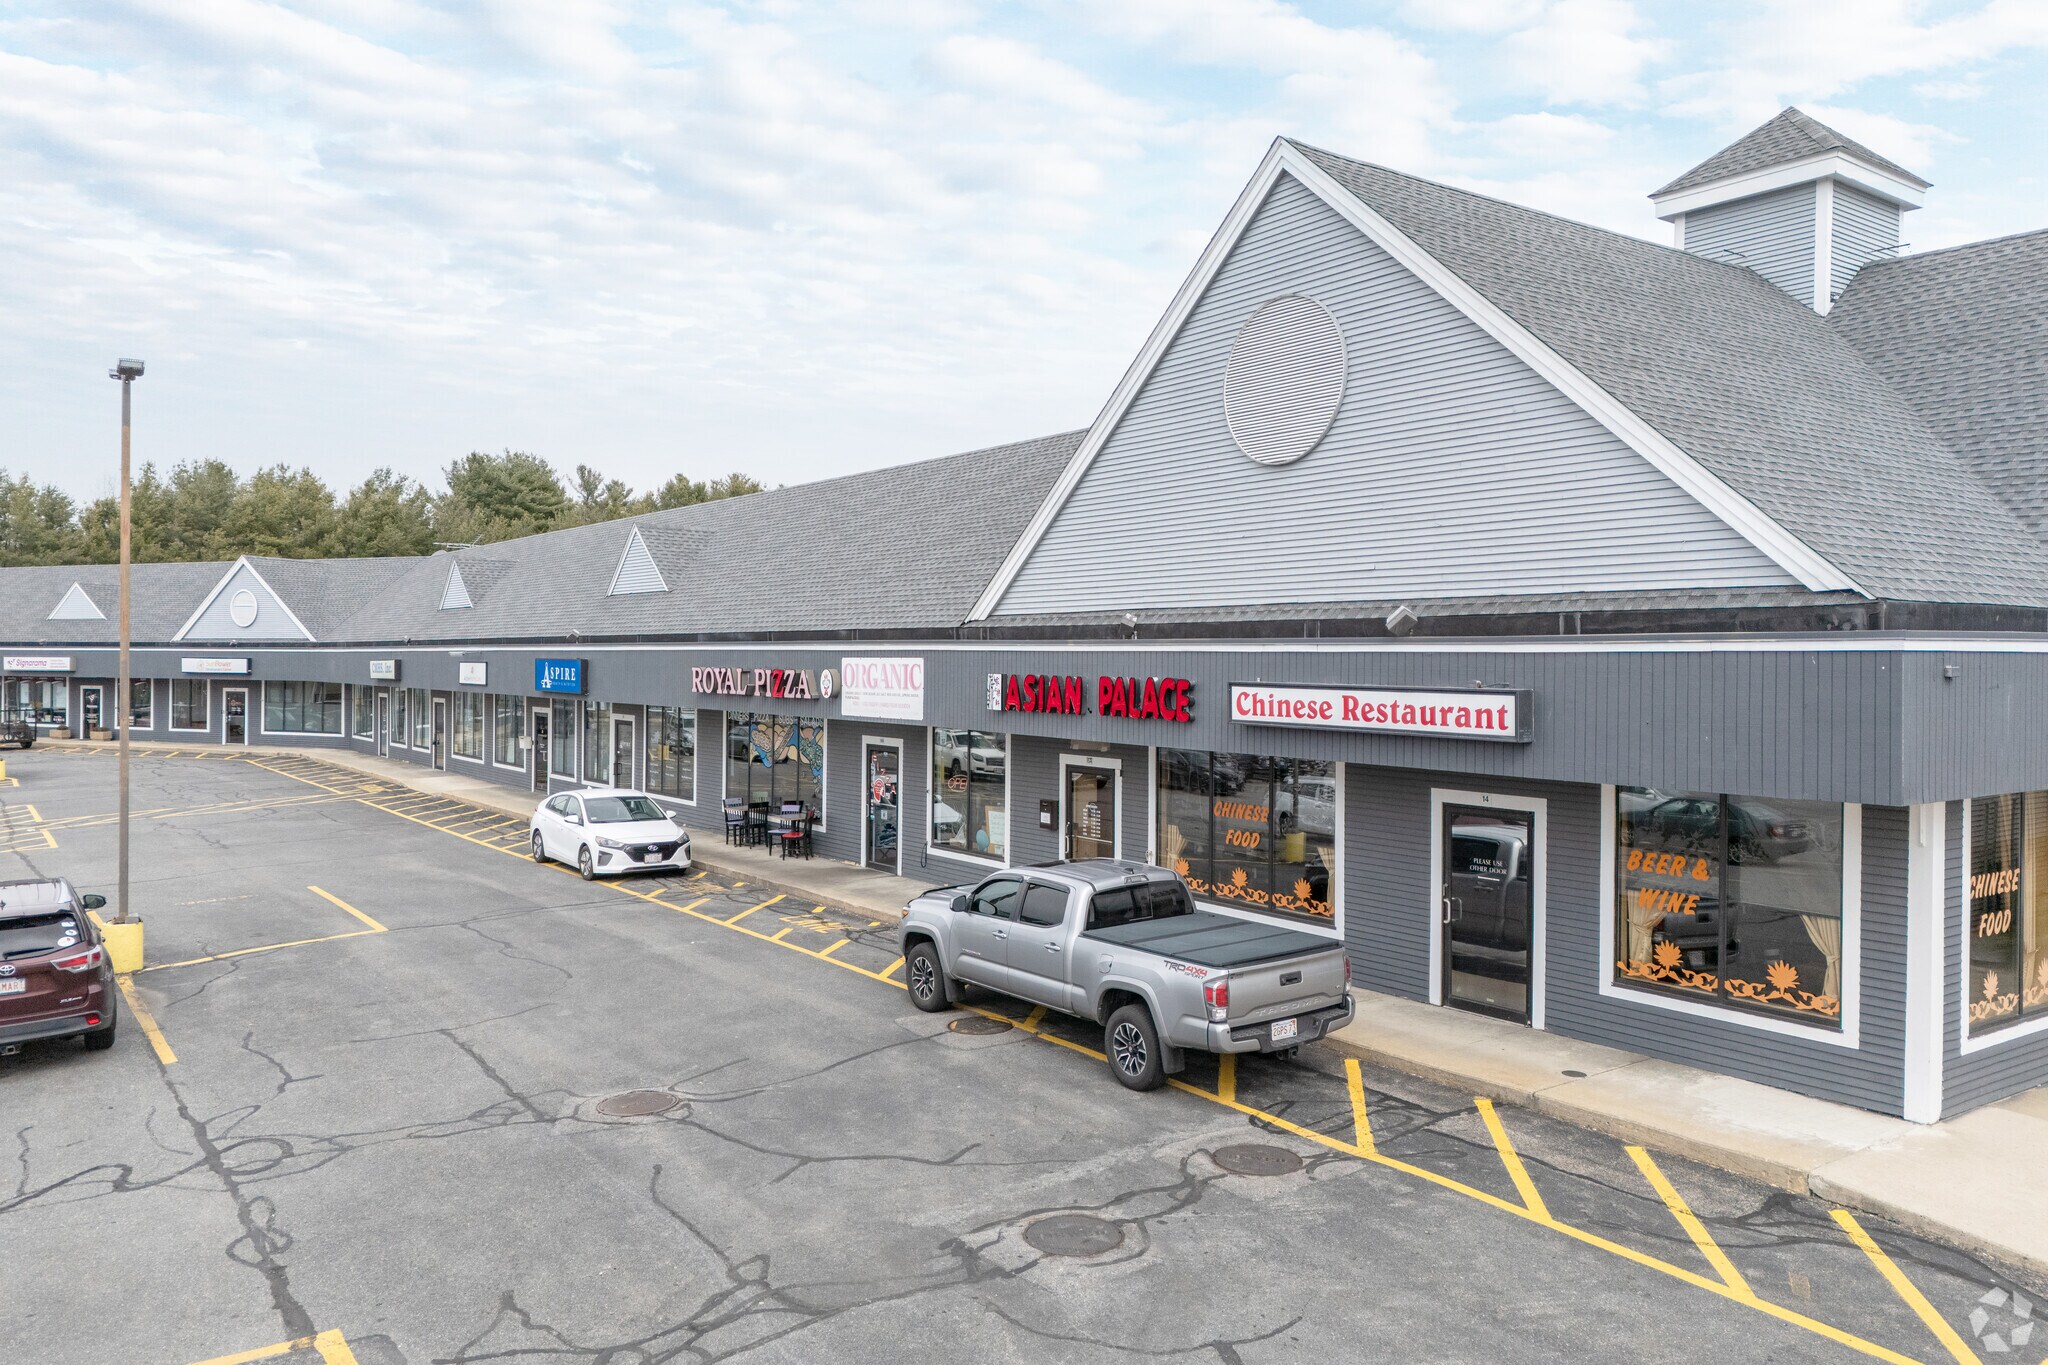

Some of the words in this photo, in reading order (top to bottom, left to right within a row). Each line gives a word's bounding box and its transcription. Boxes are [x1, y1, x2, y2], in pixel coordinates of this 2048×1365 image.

[15, 658, 47, 668] Signarama
[541, 661, 576, 688] ASPIRE
[843, 663, 922, 691] ORGANIC
[691, 666, 748, 696] ROYAL
[754, 668, 812, 700] PIZZA
[1005, 674, 1083, 716] ASIAN
[1098, 675, 1191, 723] PALACE
[1235, 691, 1333, 720] Chinese
[1341, 694, 1510, 731] Restaurant
[1213, 800, 1269, 823] CHINESE
[1225, 828, 1261, 849] FOOD
[1469, 864, 1488, 873] OTHER
[1488, 867, 1508, 875] DOOR
[1473, 857, 1491, 866] PLEASE
[1626, 849, 1687, 878] BEER
[1691, 858, 1710, 881] &
[1970, 867, 2020, 900] CHINESE
[1638, 886, 1700, 916] WINE
[1978, 909, 2012, 938] FOOD
[1255, 998, 1322, 1017] TACOMA
